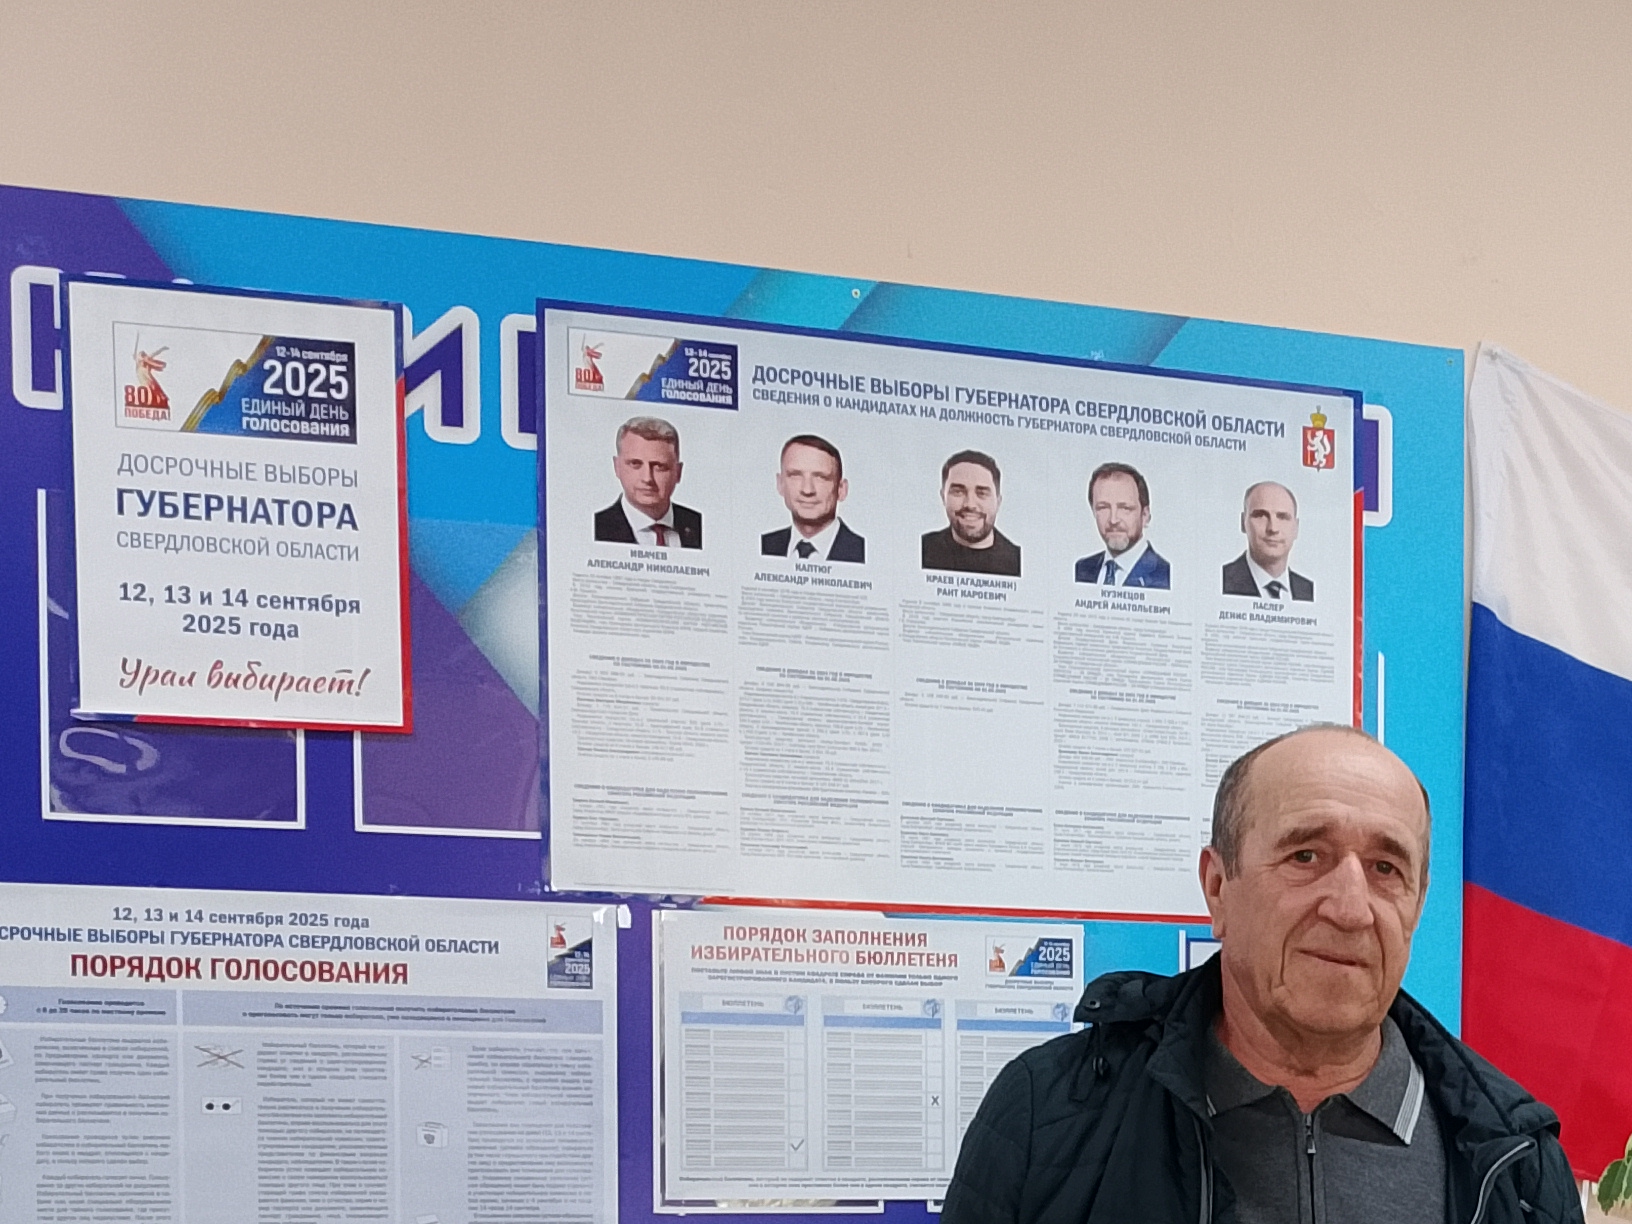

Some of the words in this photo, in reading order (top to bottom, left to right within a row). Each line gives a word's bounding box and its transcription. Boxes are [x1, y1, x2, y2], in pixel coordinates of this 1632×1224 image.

[263, 359, 349, 400] 2025
[688, 357, 732, 381] 2025
[661, 377, 704, 391] ЕДИНЫЙ
[706, 381, 734, 395] ДЕНЬ
[241, 397, 306, 418] ЕДИНЫЙ
[309, 403, 350, 421] ДЕНЬ
[751, 365, 866, 393] ДОСРОЧНЫЕ
[870, 377, 950, 402] ВЫБОРЫ
[955, 385, 1071, 416] ГУБЕРНАТОРА
[1075, 400, 1207, 430] СВЕРДЛОВСКОЙ
[1211, 415, 1285, 439] ОБЛАСТИ
[124, 407, 171, 422] ПОБЕДА!
[752, 388, 820, 407] СВЕДЕНИЯ
[823, 395, 832, 407] О
[835, 397, 917, 417] КАНДИДАТАХ
[919, 405, 937, 419] НА
[938, 407, 1015, 427] ДОЛЖНОСТЬ
[1017, 415, 1098, 436] ГУБЕРНАТОРА
[1100, 425, 1192, 446] СВЕРДЛОВСКОЙ
[1195, 435, 1247, 452] ОБЛАСТИ
[117, 453, 258, 482] ДОСРОЧНЫЕ
[264, 463, 359, 488] ВЫБОРЫ
[116, 487, 360, 532] ГУБЕРНАТОРА
[116, 531, 270, 556] СВЕРДЛОВСКОЙ
[276, 541, 359, 562] ОБЛАСТИ
[630, 549, 668, 561] ИВАЧЕВ
[587, 559, 644, 572] АЛЕКСАНДР
[646, 565, 710, 577] НИКОЛАЕВИЧ
[795, 563, 833, 575] КАПТЮГ
[753, 572, 809, 586] АЛЕКСАНДР
[811, 577, 872, 591] НИКОЛАЕВИЧ
[925, 574, 955, 585] КРАЕВ
[956, 577, 1018, 592] (АГАДЖАНЯН)
[119, 582, 155, 607] 12,
[164, 585, 192, 605] 13
[200, 590, 213, 606] и
[221, 588, 249, 608] 14
[256, 593, 361, 618] сентября
[960, 589, 1007, 602] КАРОЕВИЧ
[1075, 598, 1109, 611] АНДРЕЙ
[1110, 601, 1171, 616] АНАТОЛЬЕВИЧ
[1100, 589, 1146, 602] КУЗНЕЦОВ
[1252, 601, 1285, 612] ПАСЛЕР
[182, 613, 242, 635] 2025
[249, 621, 300, 642] года
[1218, 610, 1248, 622] ДЕНИС
[1249, 613, 1318, 626] ВЛАДИМИРОВИЧ
[119, 656, 197, 697] Урал
[206, 659, 372, 702] выбирает!
[112, 907, 139, 924] 12,
[144, 908, 164, 922] 13
[169, 911, 179, 923] и
[185, 909, 204, 924] 14
[209, 911, 283, 928] сентября
[288, 912, 329, 928] 2025
[334, 916, 370, 930] года
[87, 928, 165, 945] ВЫБОРЫ
[170, 930, 284, 948] ГУБЕРНАТОРА
[288, 934, 420, 952] СВЕРДЛОВСКОЙ
[425, 938, 500, 955] ОБЛАСТИ
[723, 925, 807, 945] ПОРЯДОК
[812, 929, 928, 948] ЗАПОЛНЕНИЯ
[690, 944, 850, 965] ИЗБИРАТЕЛЬНОГО
[855, 951, 958, 968] БЮЛЛЕТЕНЯ
[1039, 946, 1071, 962] 2025
[70, 954, 203, 983] ПОРЯДОК
[210, 957, 408, 985] ГОЛОСОВАНИЯ
[565, 963, 590, 975] 2025
